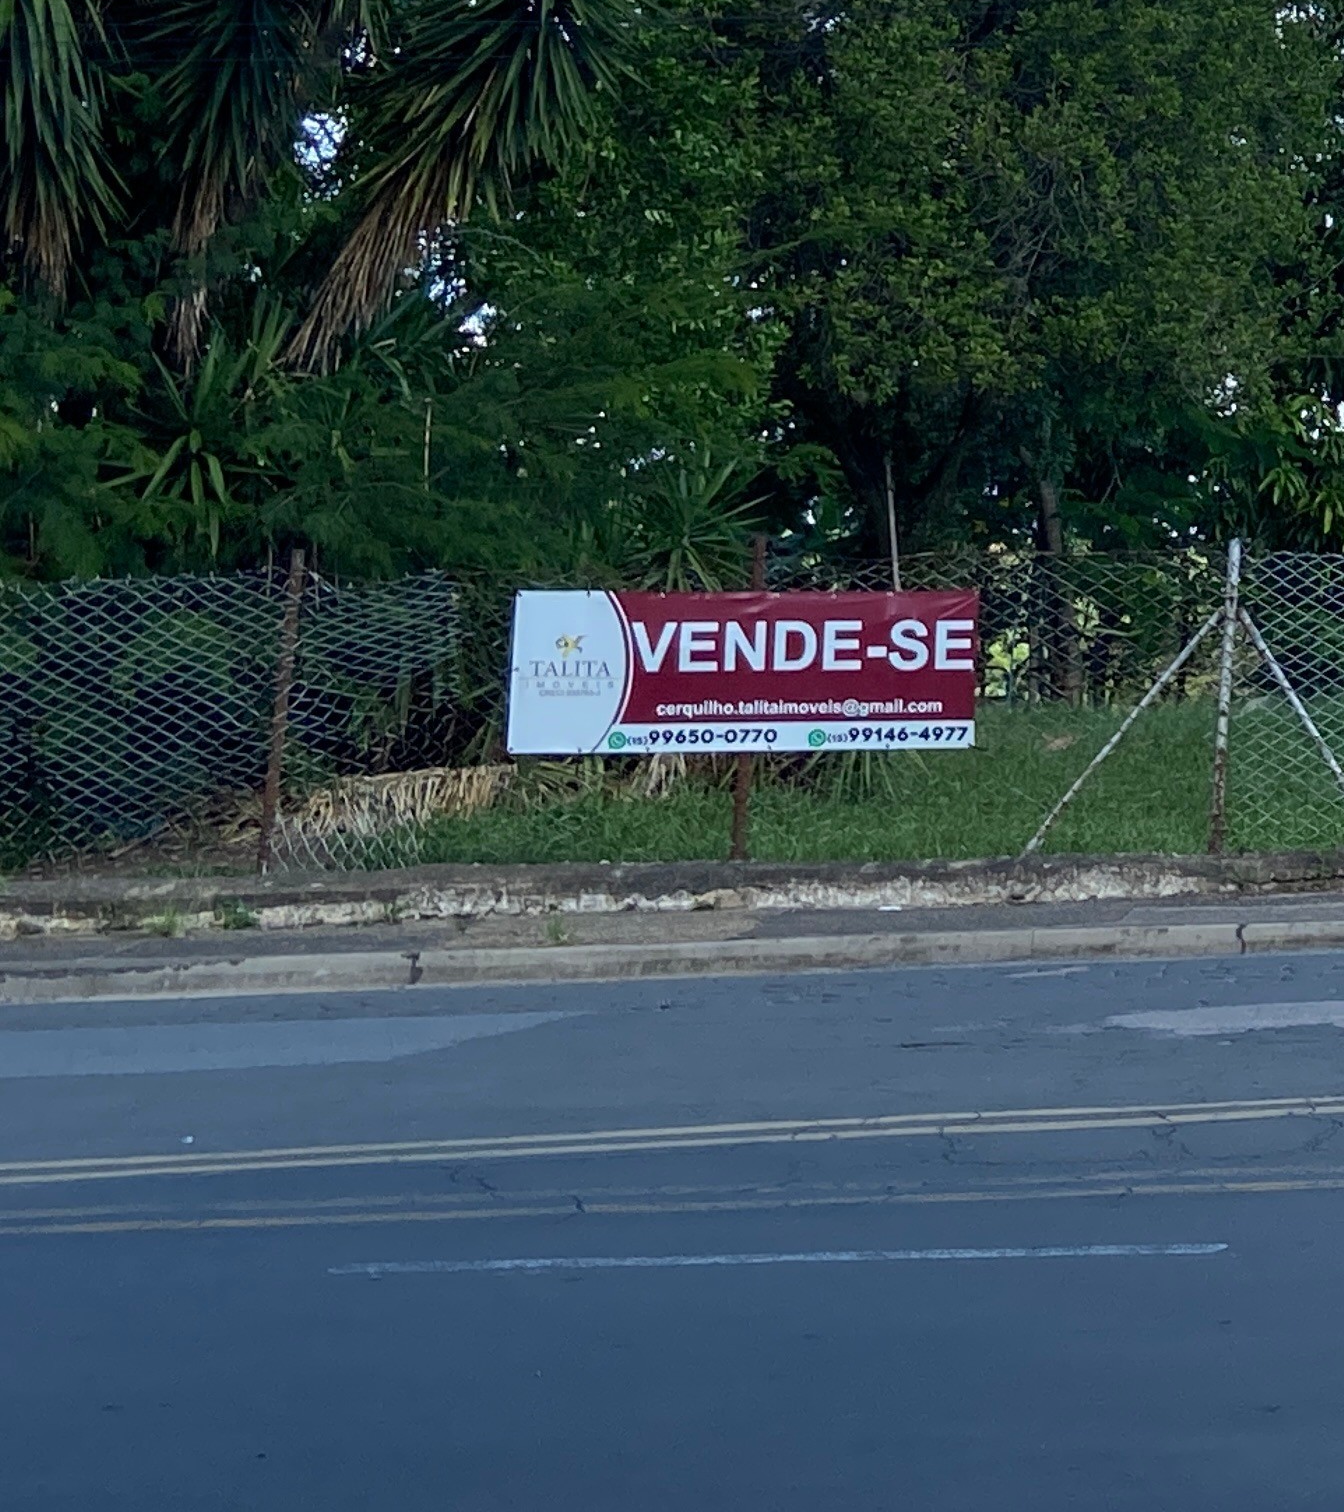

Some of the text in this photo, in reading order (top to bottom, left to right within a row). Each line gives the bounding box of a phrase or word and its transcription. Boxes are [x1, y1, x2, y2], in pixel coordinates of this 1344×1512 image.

[631, 619, 975, 673] VENDE-SE
[529, 660, 611, 678] TALITA
[656, 698, 943, 719] cerquilho.talitaimoveis@gmail.com
